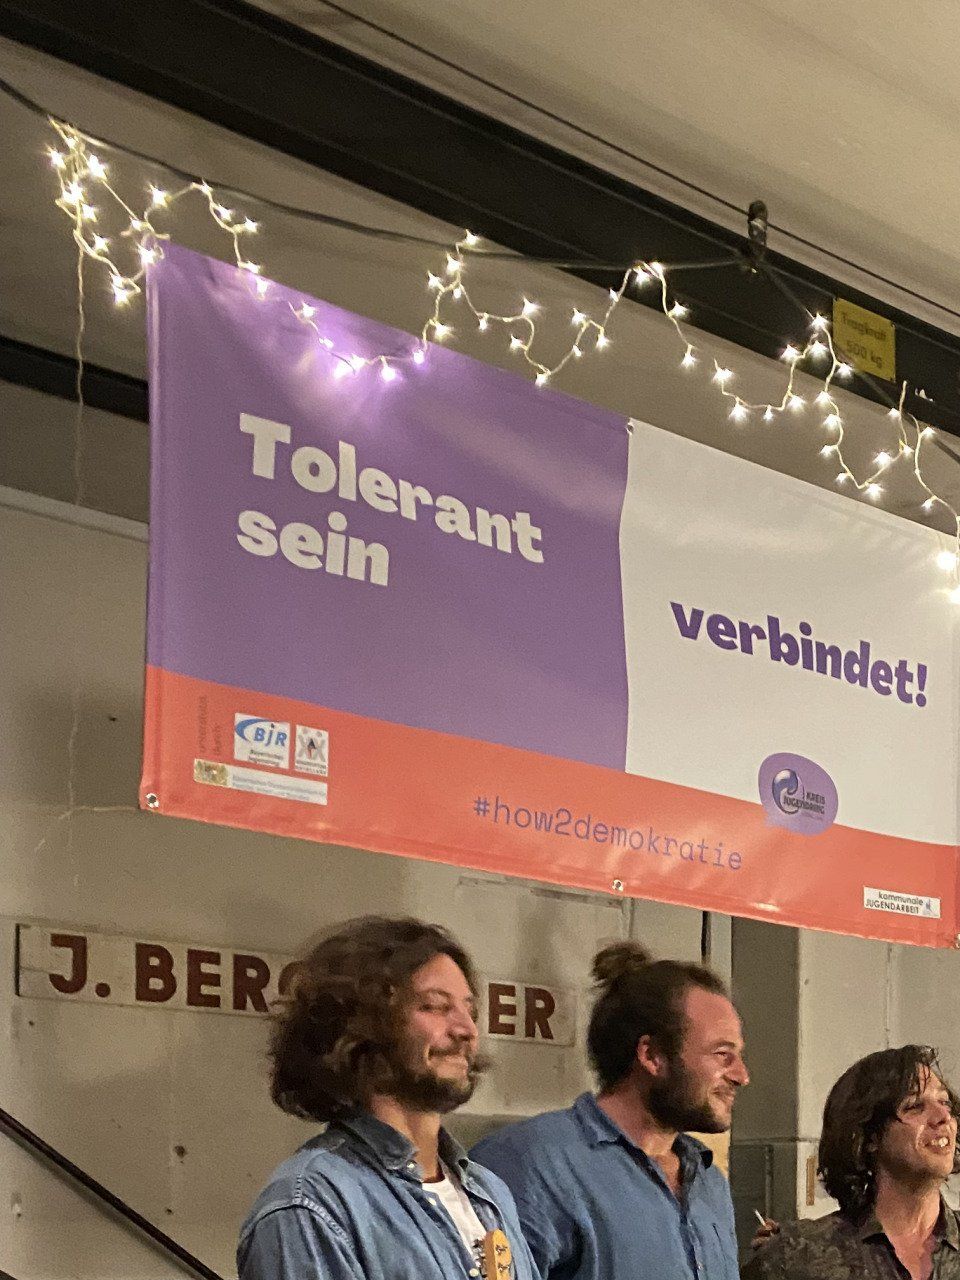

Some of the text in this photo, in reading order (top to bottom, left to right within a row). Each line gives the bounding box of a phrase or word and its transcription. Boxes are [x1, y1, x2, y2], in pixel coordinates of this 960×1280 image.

[239, 412, 545, 564] Tolerant
[236, 510, 389, 587] sein
[669, 601, 928, 707] verbindet!
[473, 795, 743, 870] #how2demokratie
[866, 898, 919, 915] JUGENDARBEIT
[878, 891, 924, 906] kommunale
[49, 933, 111, 998] J.
